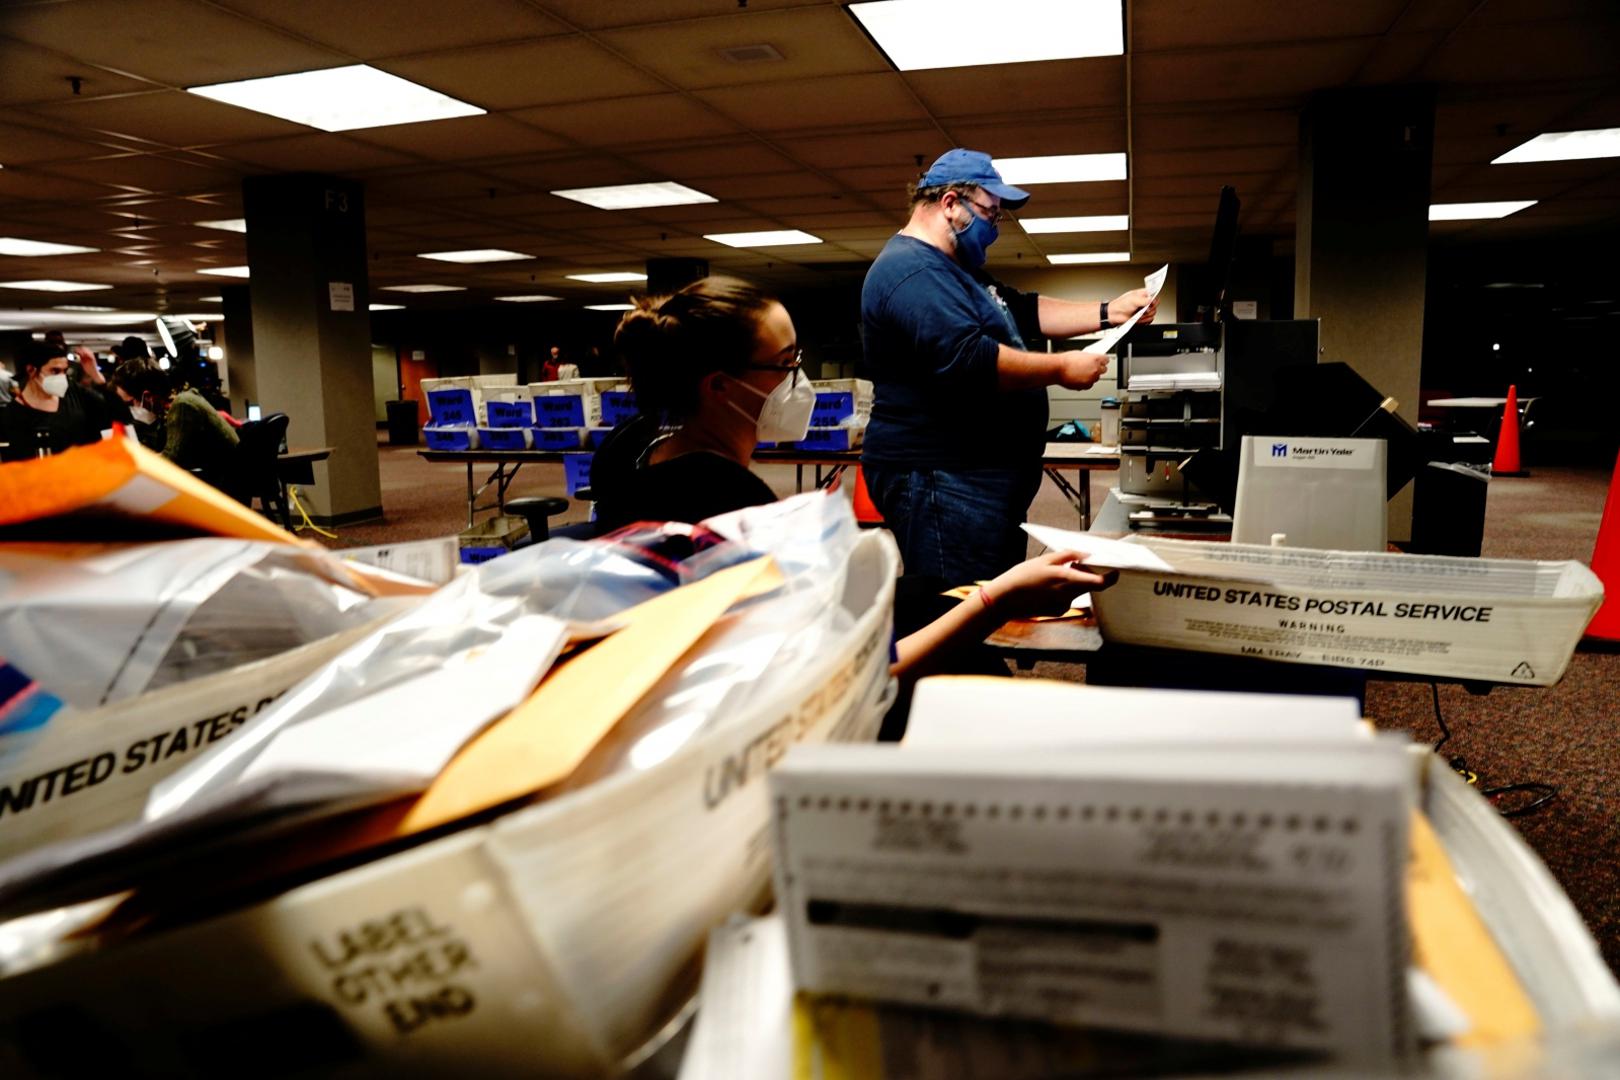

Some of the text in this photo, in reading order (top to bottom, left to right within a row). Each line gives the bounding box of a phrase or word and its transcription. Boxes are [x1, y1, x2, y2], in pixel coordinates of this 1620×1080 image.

[1153, 581, 1493, 622] UNITED STATES POSTAL SERVICE
[1278, 618, 1345, 633] WARNING
[122, 705, 249, 775] STATES
[309, 906, 453, 969] LABEL
[333, 940, 479, 1004] OTHER
[383, 985, 477, 1035] END
